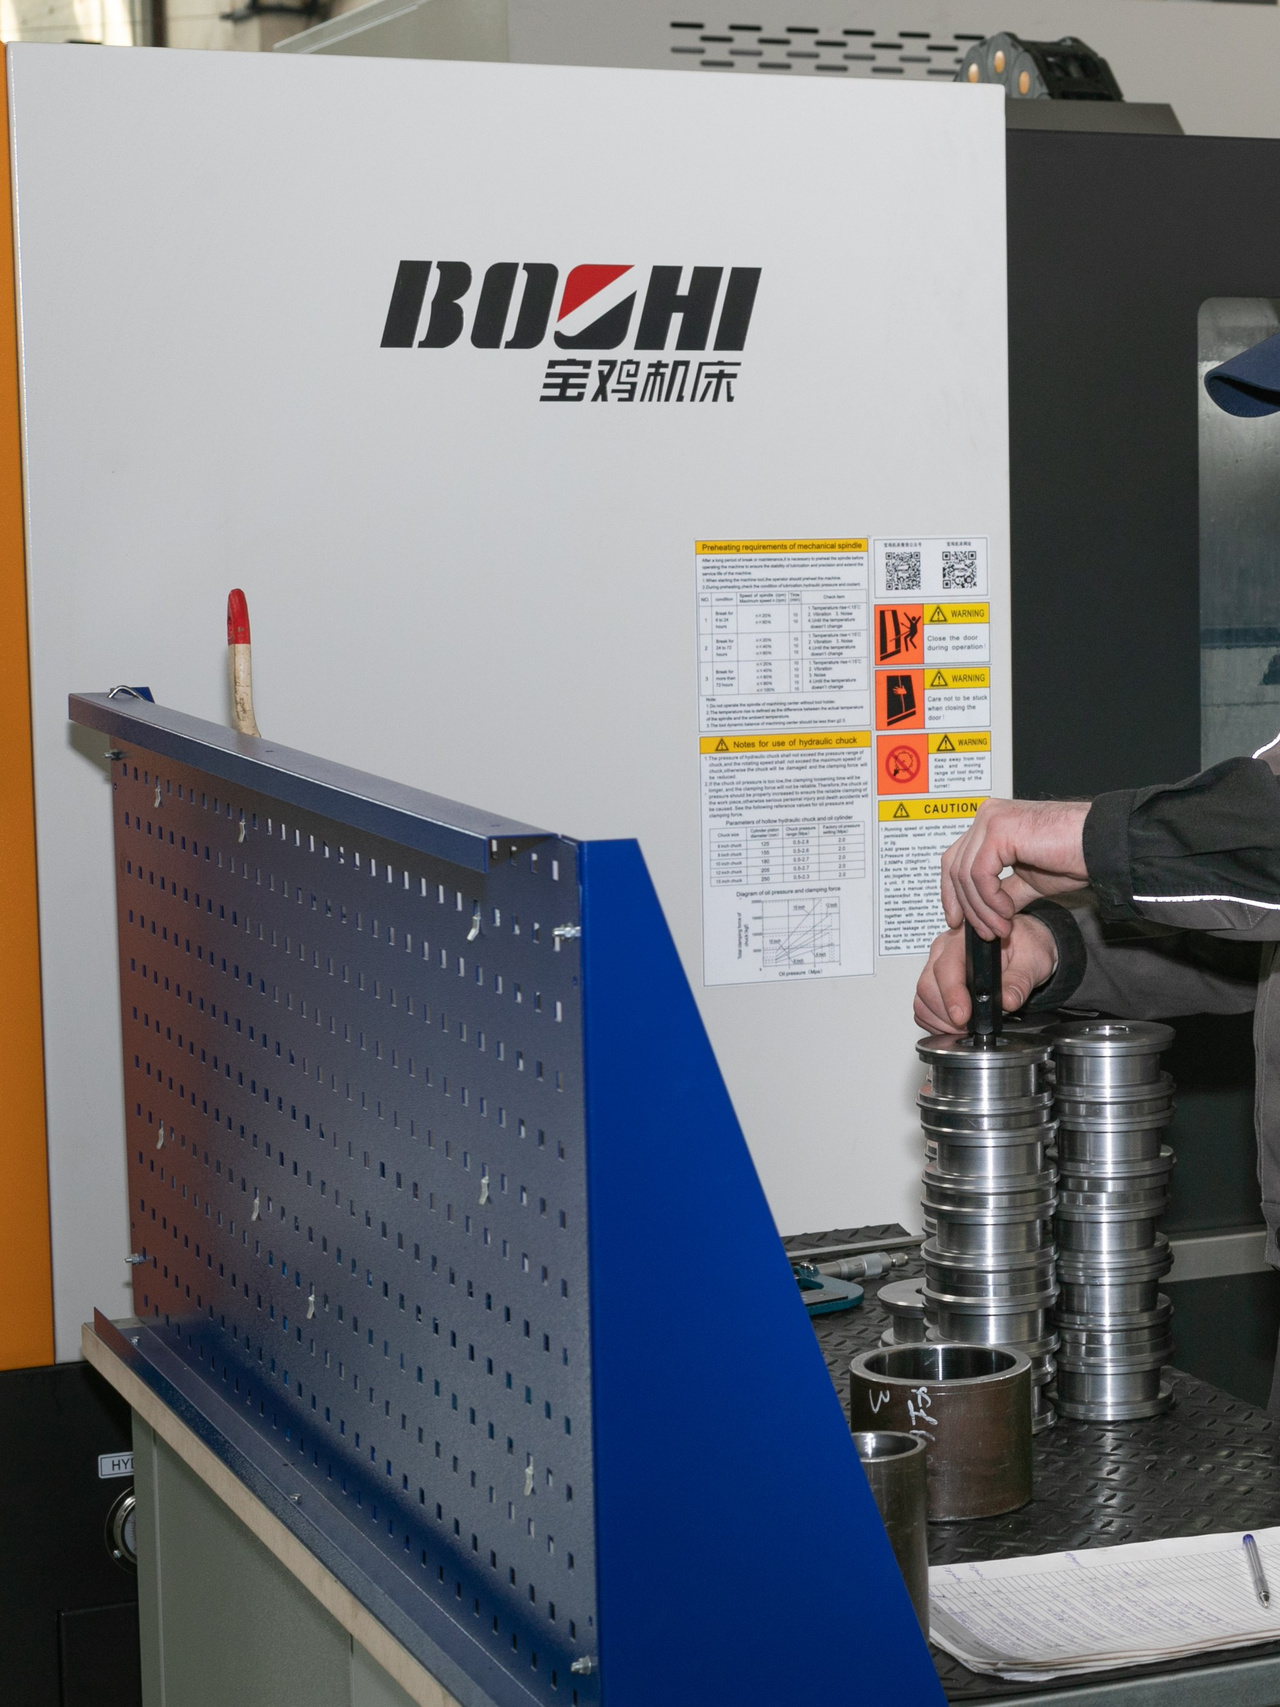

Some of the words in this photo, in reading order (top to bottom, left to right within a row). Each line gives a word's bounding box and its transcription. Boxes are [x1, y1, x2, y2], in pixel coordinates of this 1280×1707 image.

[380, 260, 762, 351] BOSHI
[540, 358, 742, 402] 宝鸡机床
[702, 544, 740, 553] Preheating
[951, 609, 984, 618] WARNING
[952, 674, 985, 682] WARNING
[799, 738, 832, 747] hydraulic
[924, 803, 977, 813] CAUTION
